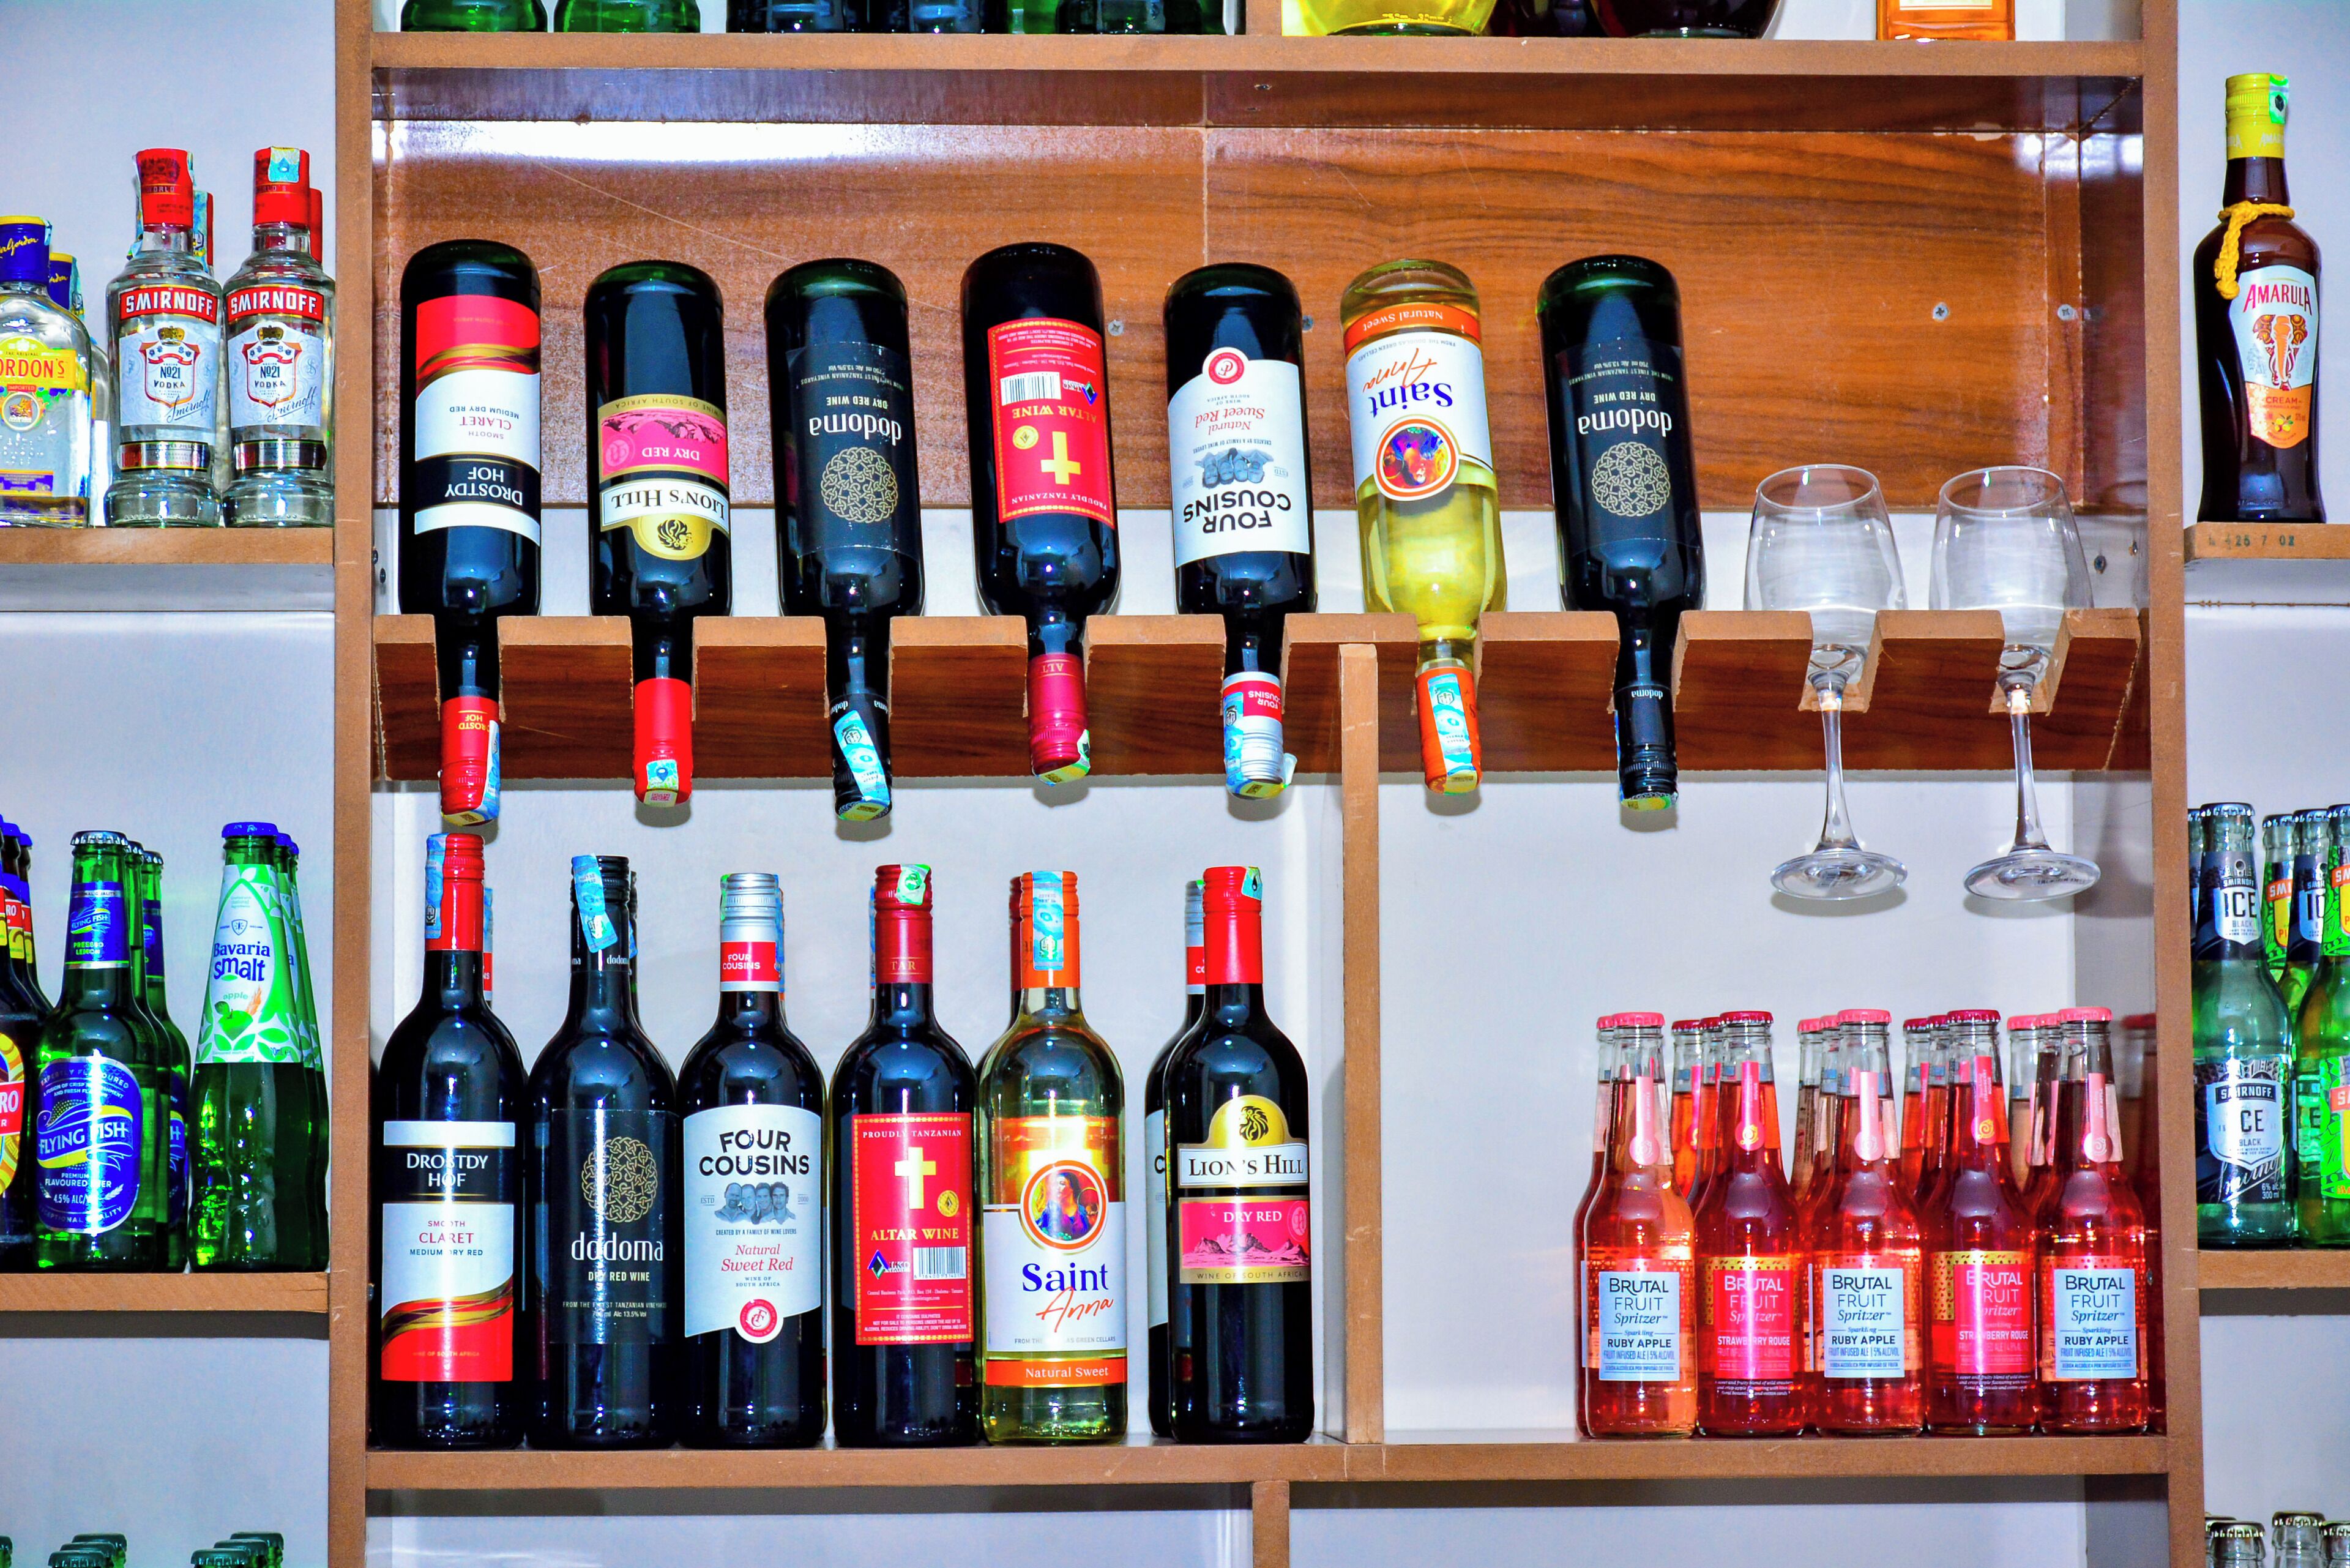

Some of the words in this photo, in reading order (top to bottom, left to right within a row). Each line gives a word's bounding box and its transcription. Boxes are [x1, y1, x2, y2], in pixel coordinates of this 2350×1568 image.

[126, 291, 213, 316] SMIRNOFF
[230, 290, 317, 316] SMIRNOFF
[2243, 283, 2313, 316] AMARULA
[1399, 309, 1444, 322] Natural
[1362, 347, 1437, 393] Anna
[1597, 368, 1629, 378] TANZANIAN
[154, 379, 185, 389] VODKA
[255, 379, 286, 389] VODKA
[1569, 371, 1597, 386] VINEYARDS
[652, 397, 684, 406] SOUTH
[826, 396, 849, 406] WINE
[852, 396, 870, 406] RED
[1368, 382, 1453, 419] Saint
[1593, 392, 1617, 405] WINE
[1620, 391, 1637, 401] RED
[1640, 392, 1656, 402] DRY
[2266, 396, 2297, 405] CREAM
[166, 390, 211, 423] Smirnoff
[449, 405, 466, 414] RED
[615, 398, 647, 409] AFRICA
[873, 398, 889, 409] DRY
[469, 406, 487, 415] DRY
[489, 409, 520, 419] MEDIUM
[1012, 405, 1053, 419] WINE
[1058, 405, 1097, 424] ALTAR
[1222, 407, 1265, 419] Sweet
[459, 414, 512, 431] CLARET
[1195, 410, 1219, 428] Red
[1577, 408, 1673, 438] dodoma
[809, 413, 902, 446] dodoma
[1208, 420, 1251, 435] Natural
[468, 430, 504, 440] SMOOTH
[641, 447, 670, 458] RED
[673, 449, 700, 461] DRY
[468, 466, 504, 482] HOF
[444, 482, 524, 506] DROSTDY
[611, 489, 663, 509] HILL
[1012, 492, 1067, 504] TANZANIAN
[669, 489, 725, 521] LION'S
[1072, 494, 1107, 510] PROUDLY
[1183, 489, 1292, 523] COUSINS
[1203, 510, 1272, 534] FOUR
[1631, 690, 1663, 700] dodoma
[1258, 698, 1278, 709] FOUR
[464, 713, 483, 722] HOF
[2223, 878, 2255, 887] SMIRNOFF
[2224, 891, 2258, 919] ICE
[213, 941, 270, 958] Bavaria
[728, 953, 752, 961] FOUR
[213, 957, 266, 982] smalt
[722, 961, 761, 970] COUSINS
[223, 991, 248, 1001] apple
[39, 1128, 86, 1154] FLYING
[719, 1129, 791, 1153] FOUR
[406, 1152, 488, 1170] DROSTDY
[699, 1154, 810, 1177] COUSINS
[1263, 1154, 1304, 1176] HILL
[45, 1178, 88, 1187] FLAVOURED
[428, 1173, 466, 1187] HOF
[2261, 1182, 2271, 1191] 6%
[53, 1194, 70, 1204] 4.5%
[1223, 1211, 1253, 1223] DRY
[1256, 1210, 1282, 1222] RED
[419, 1232, 474, 1245] CLARET
[870, 1228, 918, 1241] ALTAR
[921, 1227, 960, 1241] WINE
[571, 1231, 664, 1262] dodoma
[734, 1244, 781, 1256] Natural
[721, 1258, 764, 1272] Sweet
[767, 1256, 794, 1271] Red
[610, 1271, 627, 1282] RED
[630, 1271, 650, 1282] WINE
[1021, 1262, 1110, 1292] Saint
[1609, 1278, 1669, 1296] BRUTAL
[1832, 1275, 1893, 1293] BRUTAL
[2065, 1275, 2125, 1293] BRUTAL
[1614, 1297, 1663, 1311] FRUIT
[1837, 1294, 1887, 1308] FRUIT
[2072, 1294, 2121, 1309] FRUIT
[1035, 1286, 1114, 1333] Anna
[1768, 1336, 1791, 1346] ROUGE
[1832, 1335, 1858, 1345] RUBY
[1860, 1335, 1895, 1345] APPLE
[2010, 1330, 2029, 1340] ROUGE
[2064, 1336, 2093, 1346] RUBY
[2096, 1335, 2129, 1345] APPLE
[1608, 1338, 1634, 1348] RUBY
[1637, 1338, 1672, 1348] APPLE
[1616, 1350, 1636, 1361] INFUSED
[1636, 1350, 1646, 1361] ALE
[1840, 1347, 1860, 1357] INFUSED
[2074, 1348, 2094, 1357] INFUSED
[2095, 1348, 2105, 1357] ALE
[1026, 1366, 1072, 1378] Natural
[1075, 1366, 1109, 1378] Sweet
